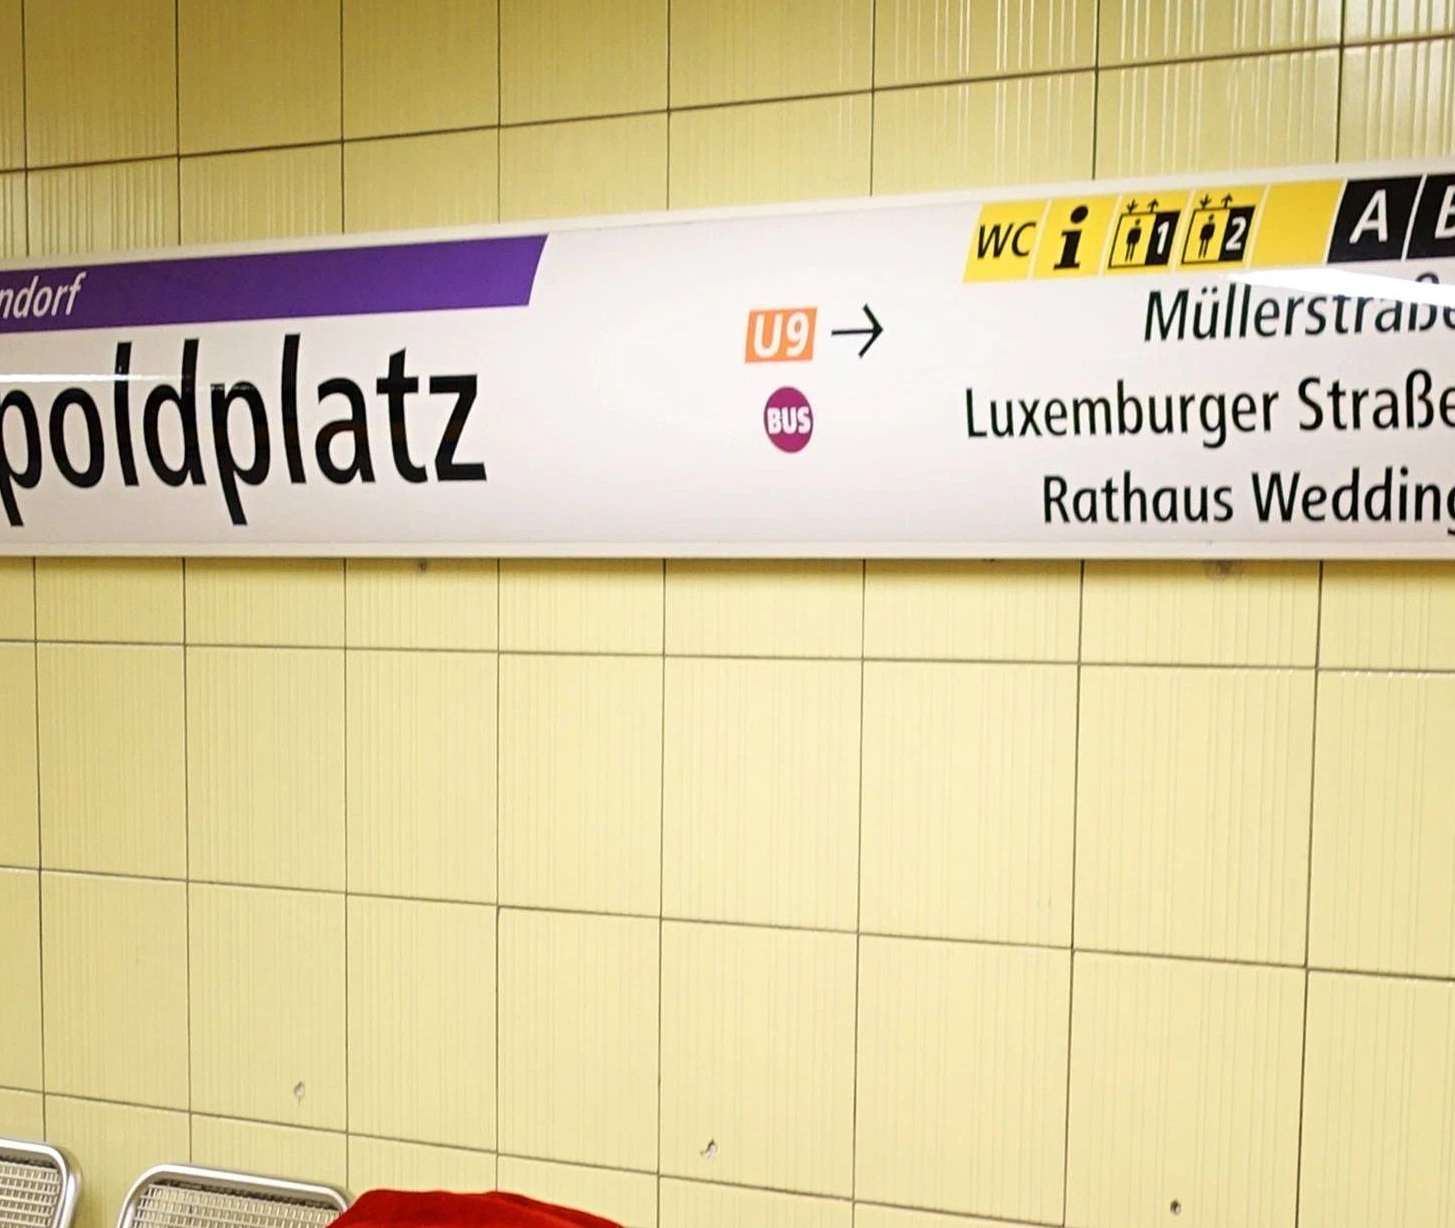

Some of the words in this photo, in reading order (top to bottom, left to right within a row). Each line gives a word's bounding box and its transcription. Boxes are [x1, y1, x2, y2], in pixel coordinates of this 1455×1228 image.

[976, 220, 1039, 260] WC
[1153, 219, 1172, 256] 1
[1224, 216, 1246, 252] 2
[1349, 188, 1391, 245] A
[753, 310, 811, 359] U9
[766, 404, 812, 435] BUS
[965, 379, 1281, 449] Luxemburger
[1043, 470, 1234, 524] Rathaus
